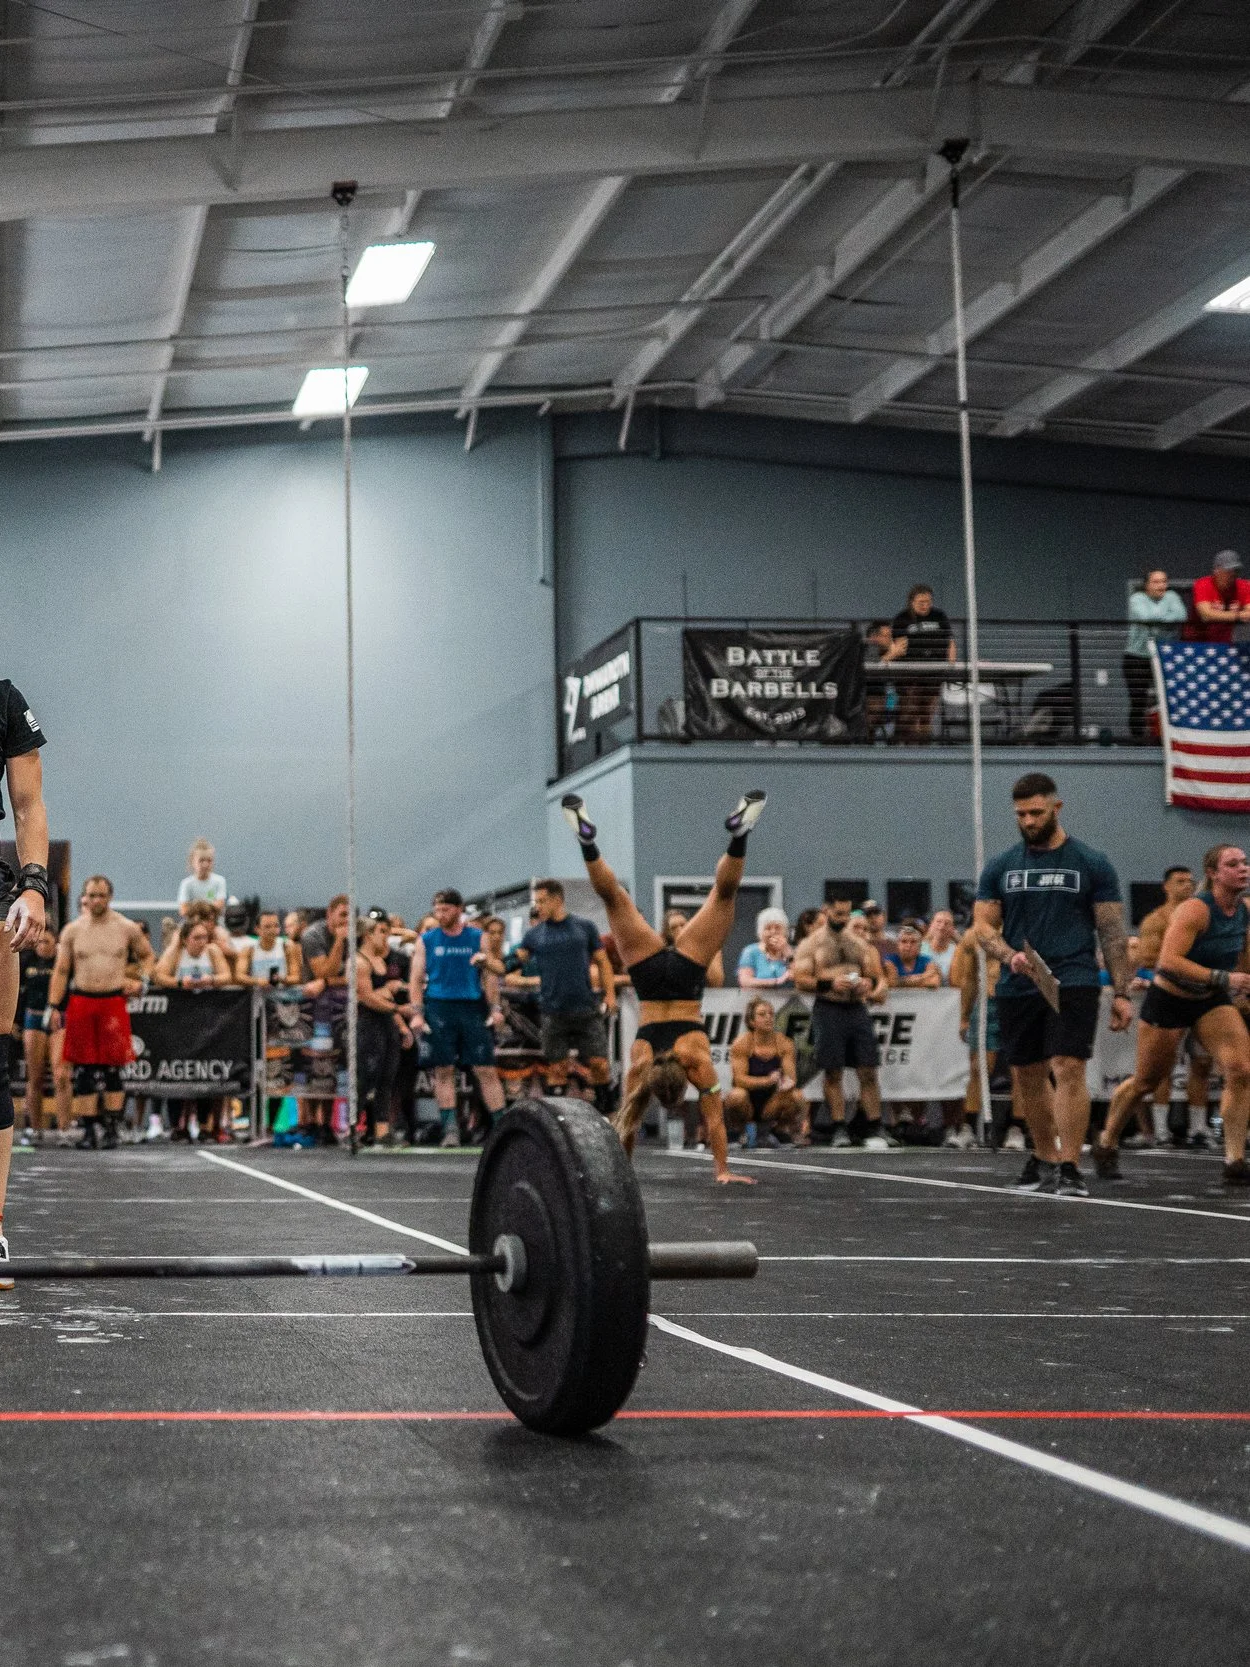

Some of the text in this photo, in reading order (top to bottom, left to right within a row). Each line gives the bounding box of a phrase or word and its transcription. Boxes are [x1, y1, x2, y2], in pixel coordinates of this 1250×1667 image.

[727, 646, 821, 667] BATTLE
[710, 678, 839, 699] BARBELLS
[125, 995, 169, 1014] arm
[156, 1059, 233, 1081] AGENCY
